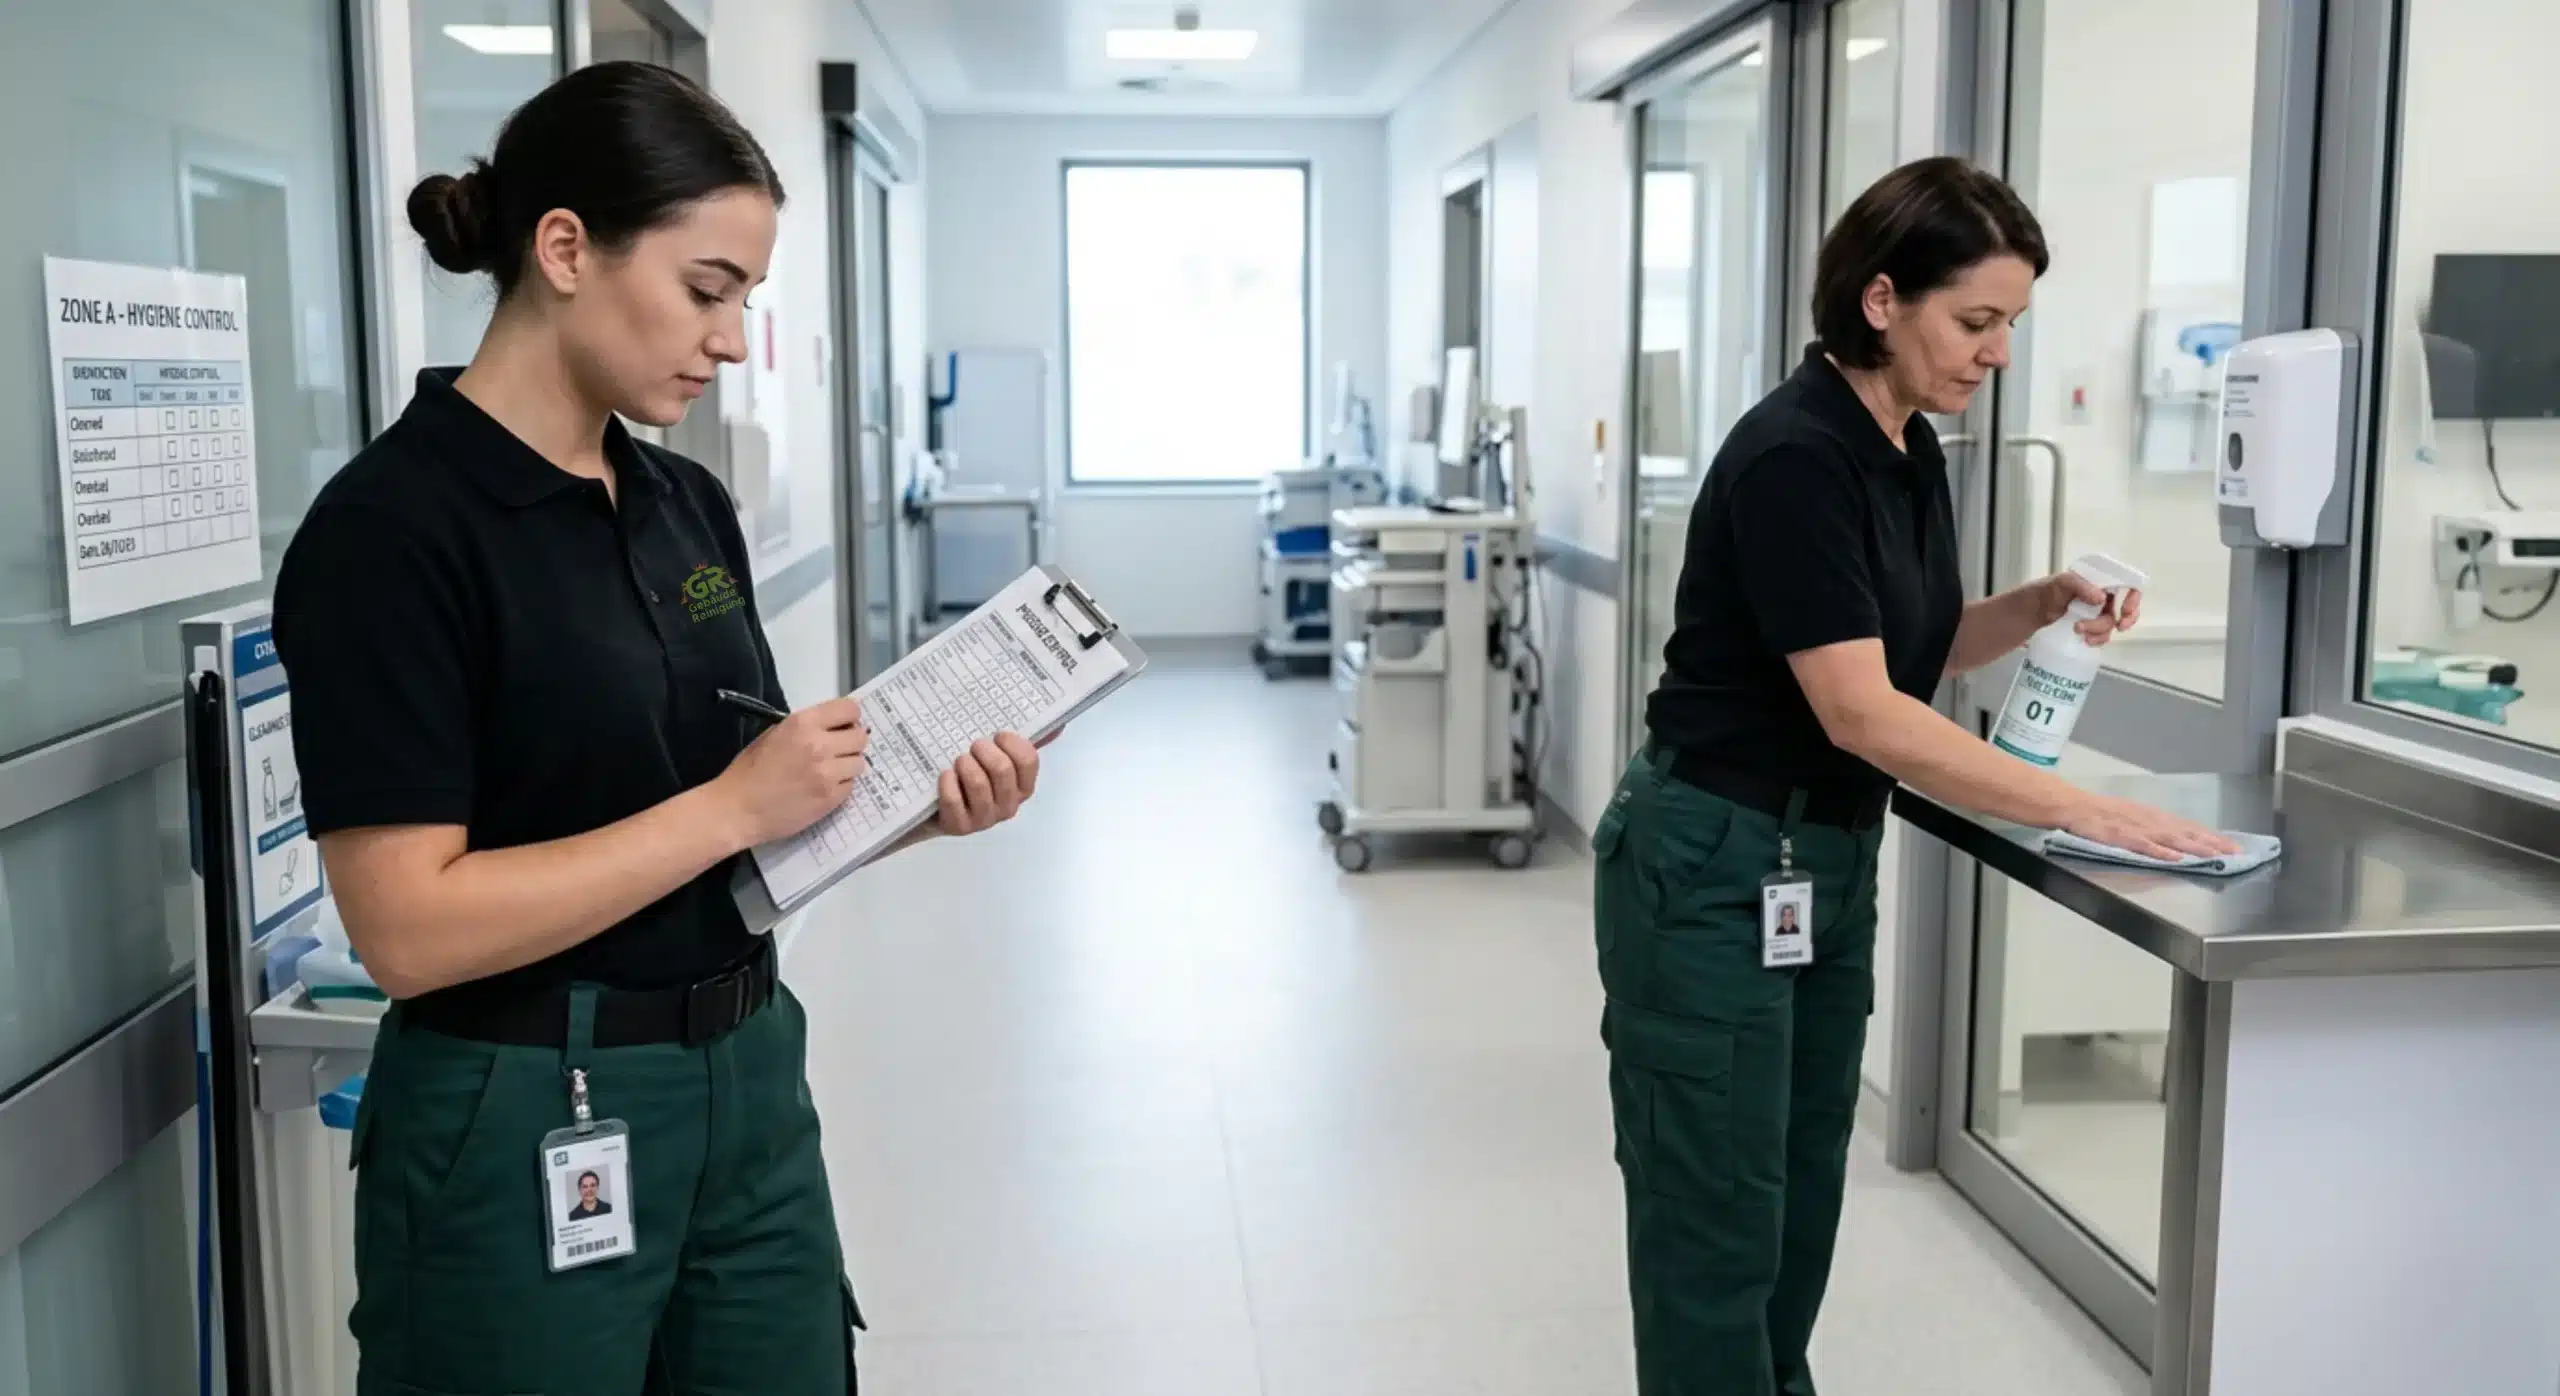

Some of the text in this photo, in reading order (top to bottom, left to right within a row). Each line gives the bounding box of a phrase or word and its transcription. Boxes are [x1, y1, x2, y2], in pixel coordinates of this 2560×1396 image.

[60, 298, 102, 324] ZONE
[105, 302, 116, 325] A
[127, 303, 182, 329] HYGIENE
[184, 308, 239, 332] CONTROL
[685, 566, 731, 599] GR
[2026, 701, 2055, 725] 01
